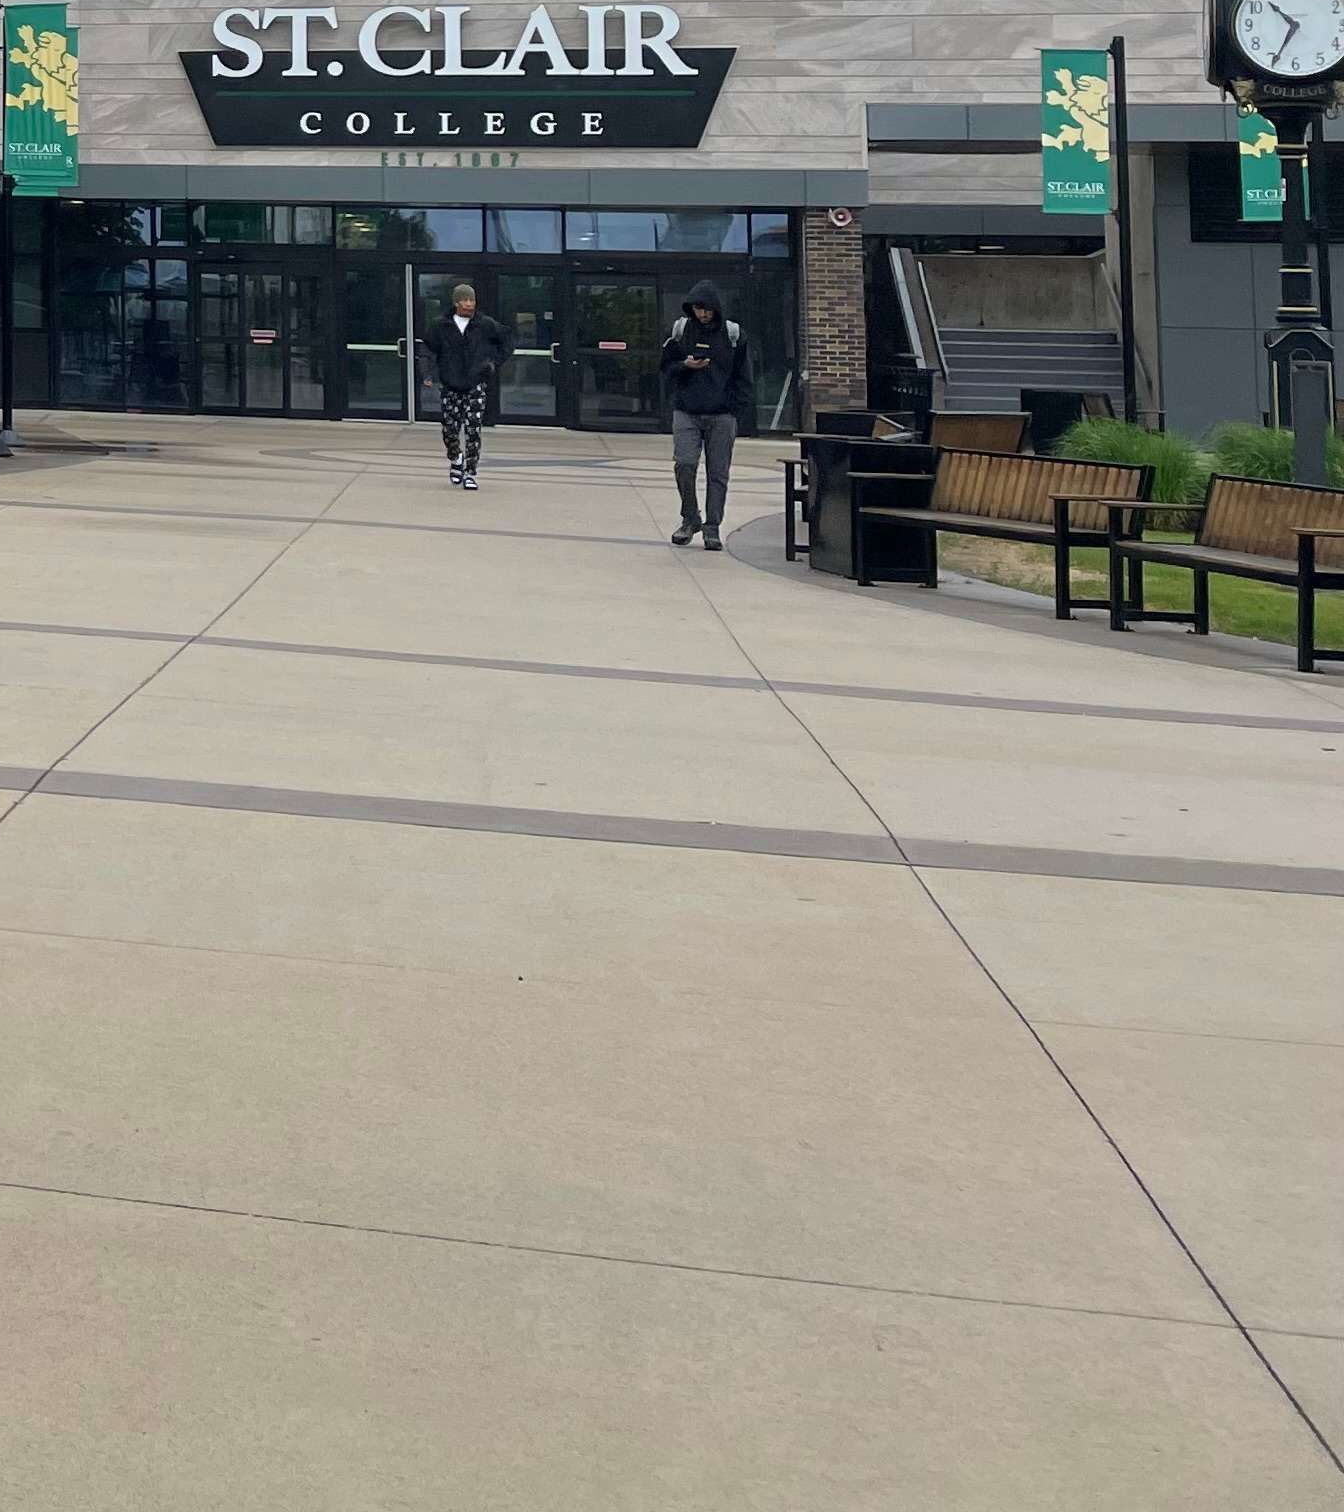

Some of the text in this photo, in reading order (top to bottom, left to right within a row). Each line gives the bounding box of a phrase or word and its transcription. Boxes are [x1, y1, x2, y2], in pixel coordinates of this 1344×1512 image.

[1249, 0, 1262, 14] 10
[1332, 0, 1341, 14] 2
[1244, 19, 1253, 32] 9
[212, 4, 699, 78] ST. CLAIR
[1251, 37, 1261, 51] 8
[1332, 37, 1341, 51] 4
[1291, 57, 1300, 71] 6
[1315, 53, 1325, 66] 5
[300, 111, 604, 136] COLLEGE
[25, 143, 62, 153] CLAIR
[1065, 182, 1105, 192] CLAIR
